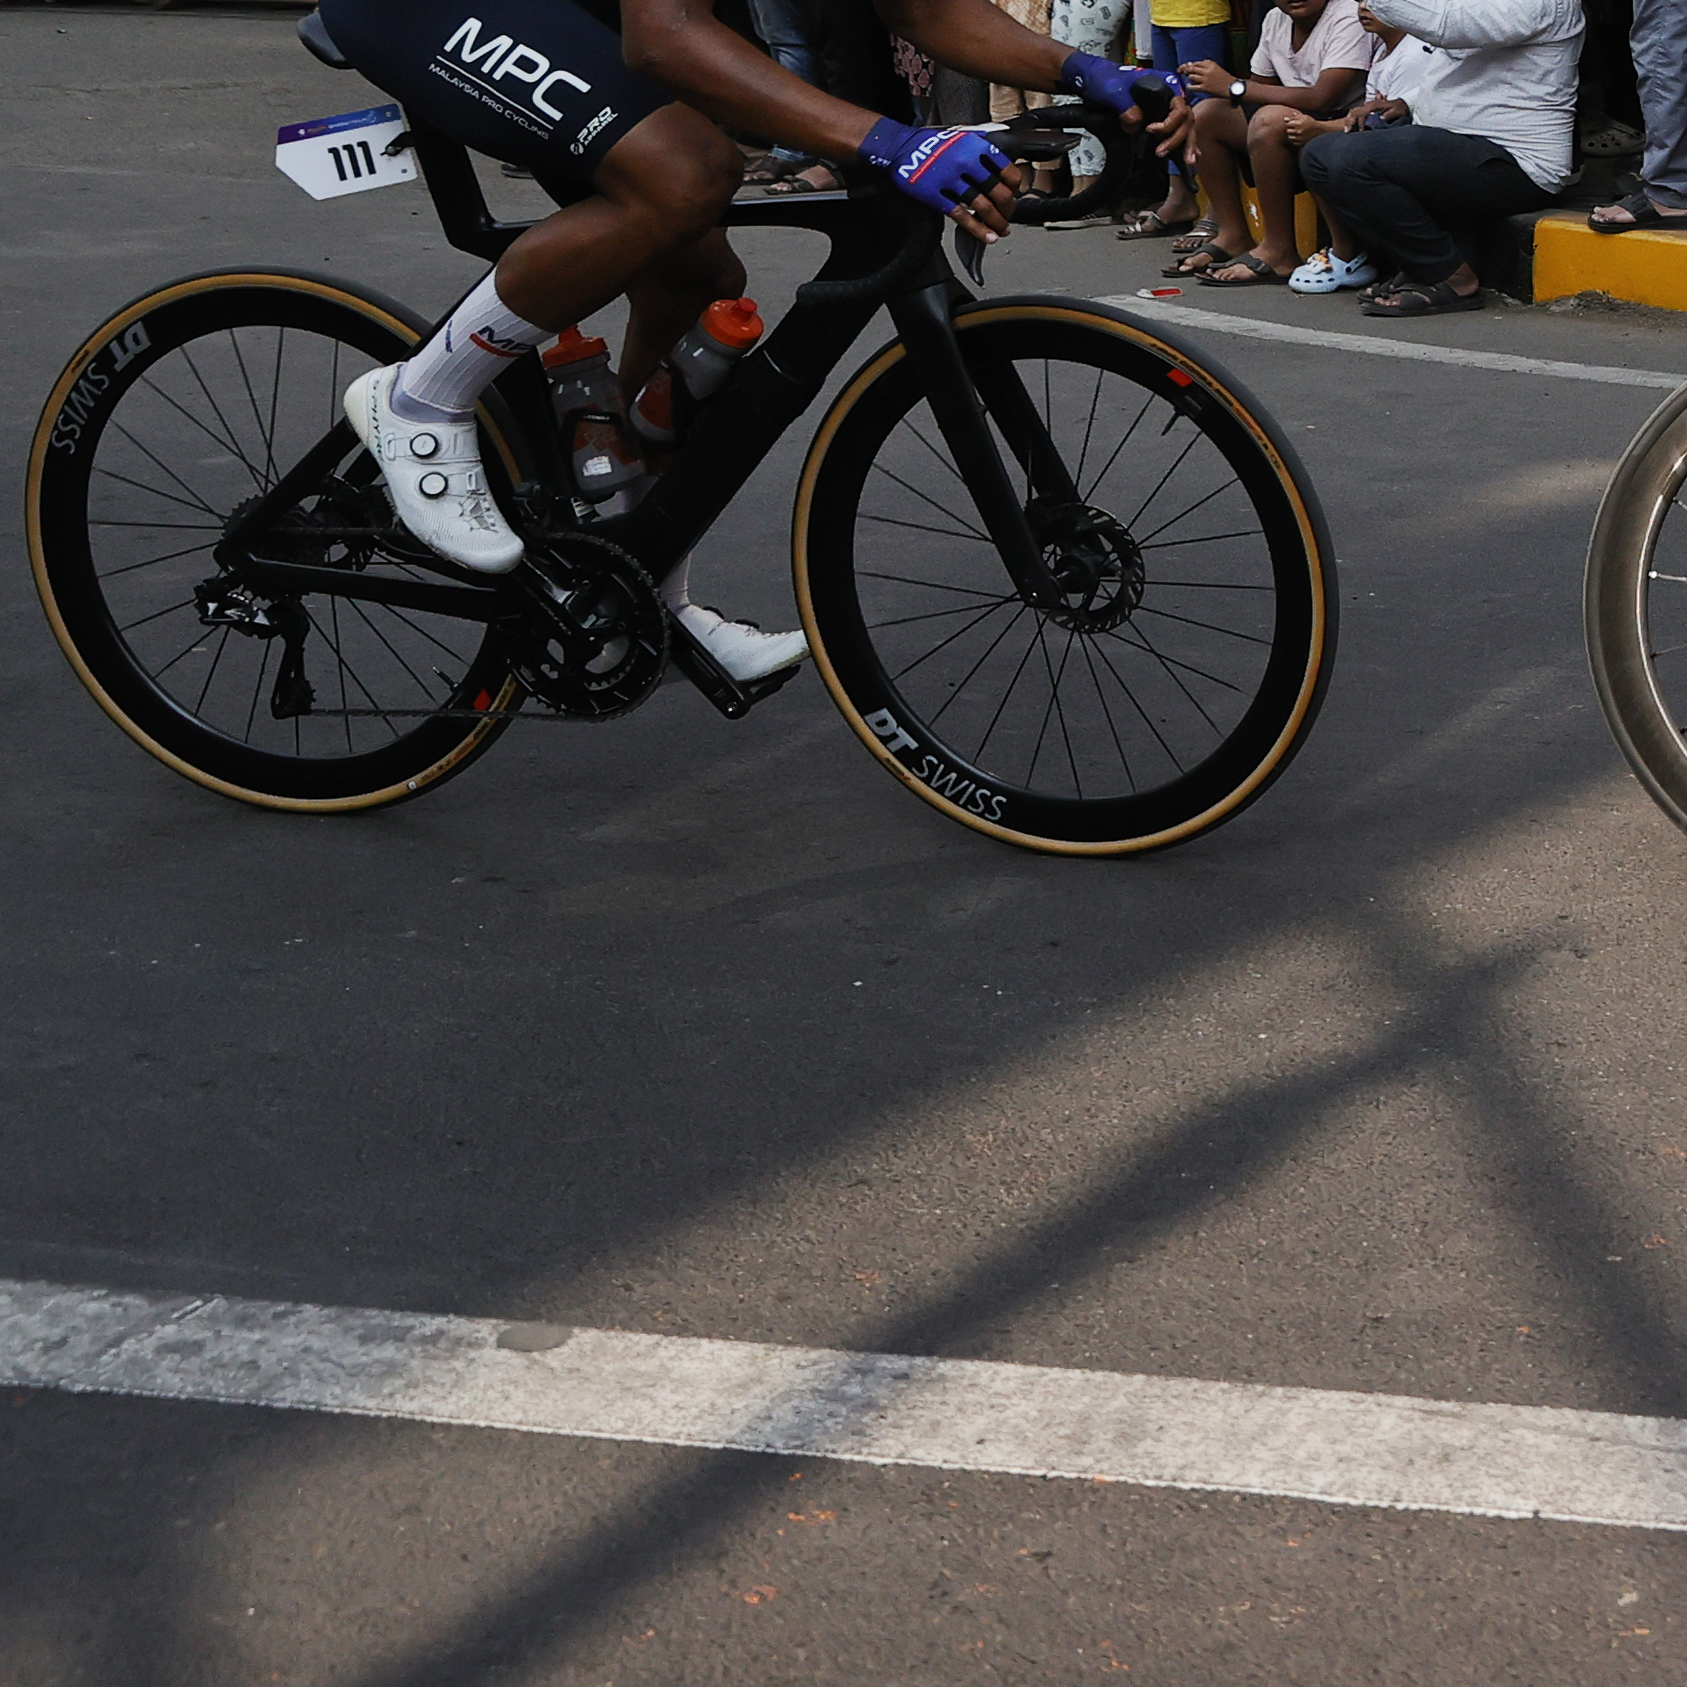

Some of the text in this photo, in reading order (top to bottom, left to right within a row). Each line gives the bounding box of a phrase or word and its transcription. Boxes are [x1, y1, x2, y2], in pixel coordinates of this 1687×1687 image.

[428, 63, 550, 140] MALAYSIA PRO CYCLING
[443, 17, 592, 121] MPC
[327, 141, 377, 181] 111
[577, 106, 613, 142] PRO
[51, 320, 152, 455] DT SWISS
[864, 709, 1007, 822] DT SWISS
